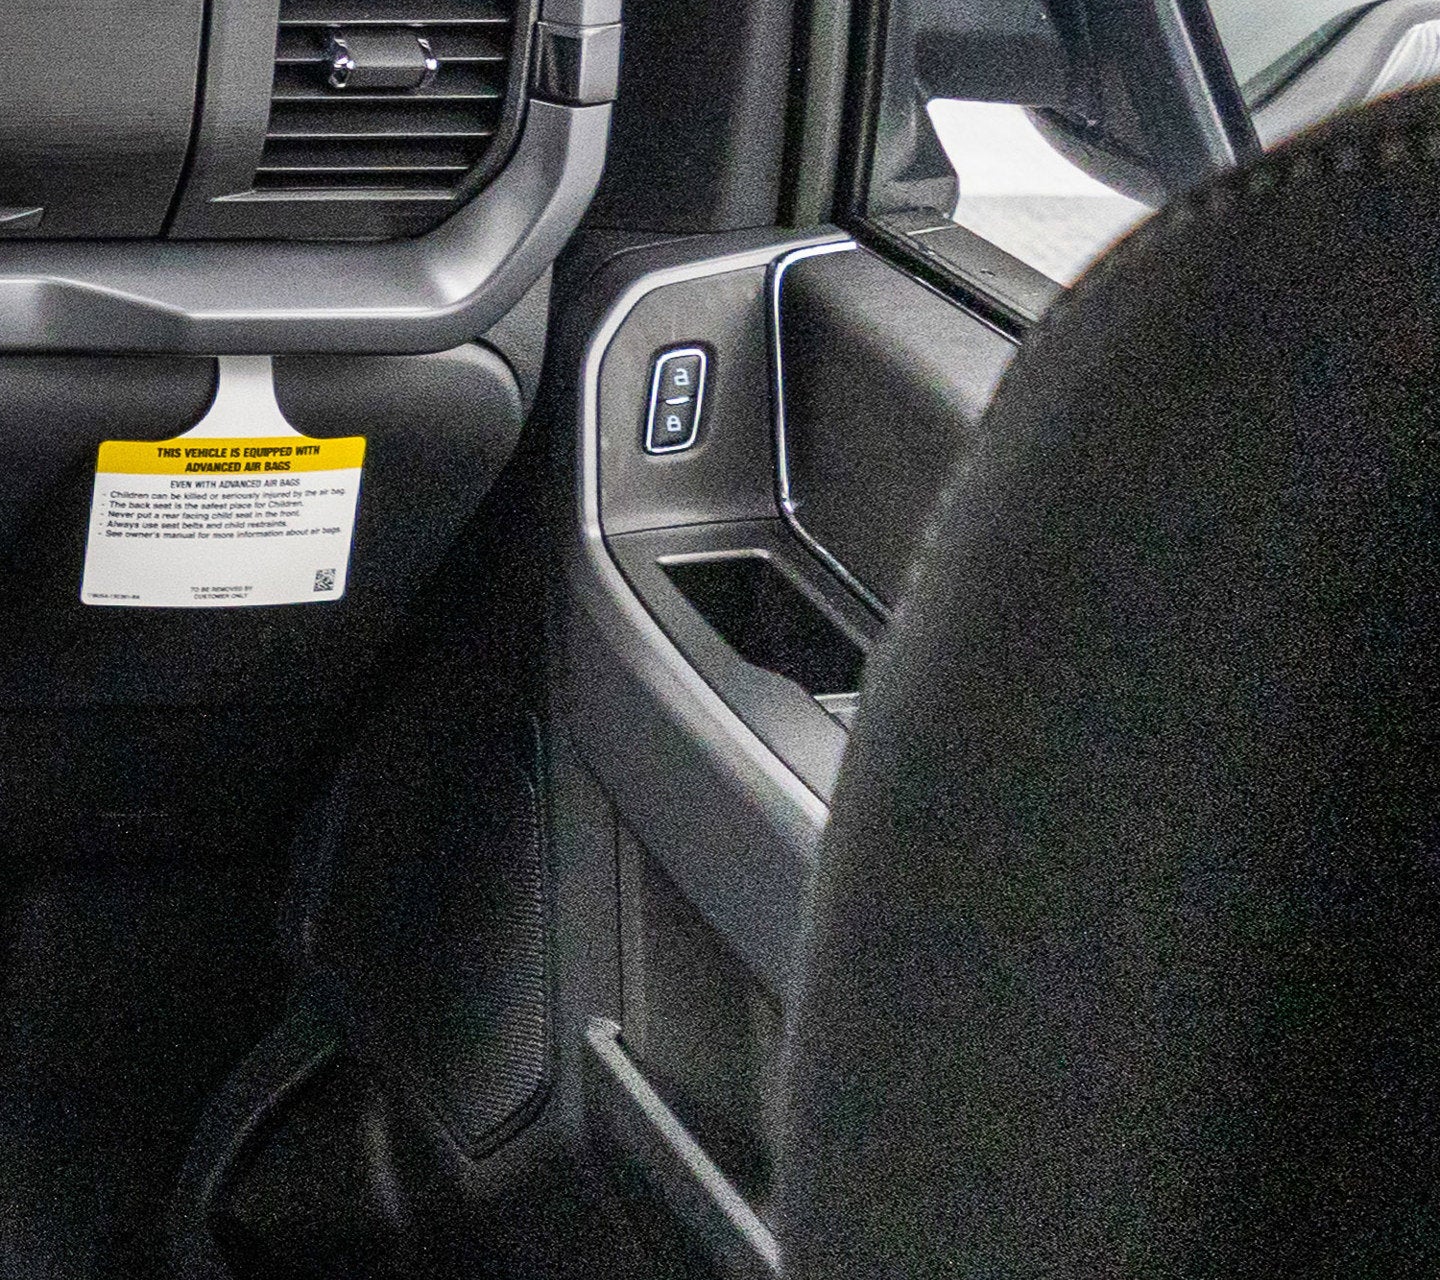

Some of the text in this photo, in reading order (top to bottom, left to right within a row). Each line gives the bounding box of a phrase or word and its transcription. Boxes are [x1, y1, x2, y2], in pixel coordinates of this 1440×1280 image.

[157, 445, 321, 458] THIS VEHICLE IS EQUIPPED WITH
[185, 460, 291, 472] ADVANCED AIR BAGS
[170, 478, 301, 489] EVEN WITH ADVANCED AIR BAGS
[110, 490, 149, 499] Children
[170, 492, 181, 500] be
[184, 492, 207, 500] killed
[221, 492, 259, 500] seriously
[262, 490, 291, 500] injured
[293, 490, 302, 498] by
[109, 500, 126, 509] The
[128, 501, 150, 509] back
[184, 501, 198, 509] the
[201, 502, 227, 510] safest
[229, 501, 252, 510] place
[254, 501, 266, 509] for
[108, 510, 135, 518] Never
[137, 511, 151, 520] put
[182, 511, 209, 520] facing
[211, 511, 233, 519] child
[265, 510, 278, 518] the
[106, 520, 139, 529] Always
[182, 521, 203, 529] belts
[224, 521, 245, 529] child
[105, 529, 123, 538] See
[124, 531, 160, 539] owner's
[163, 531, 196, 539] manual
[198, 531, 210, 539] for
[236, 530, 284, 538] information
[285, 529, 308, 537] about
